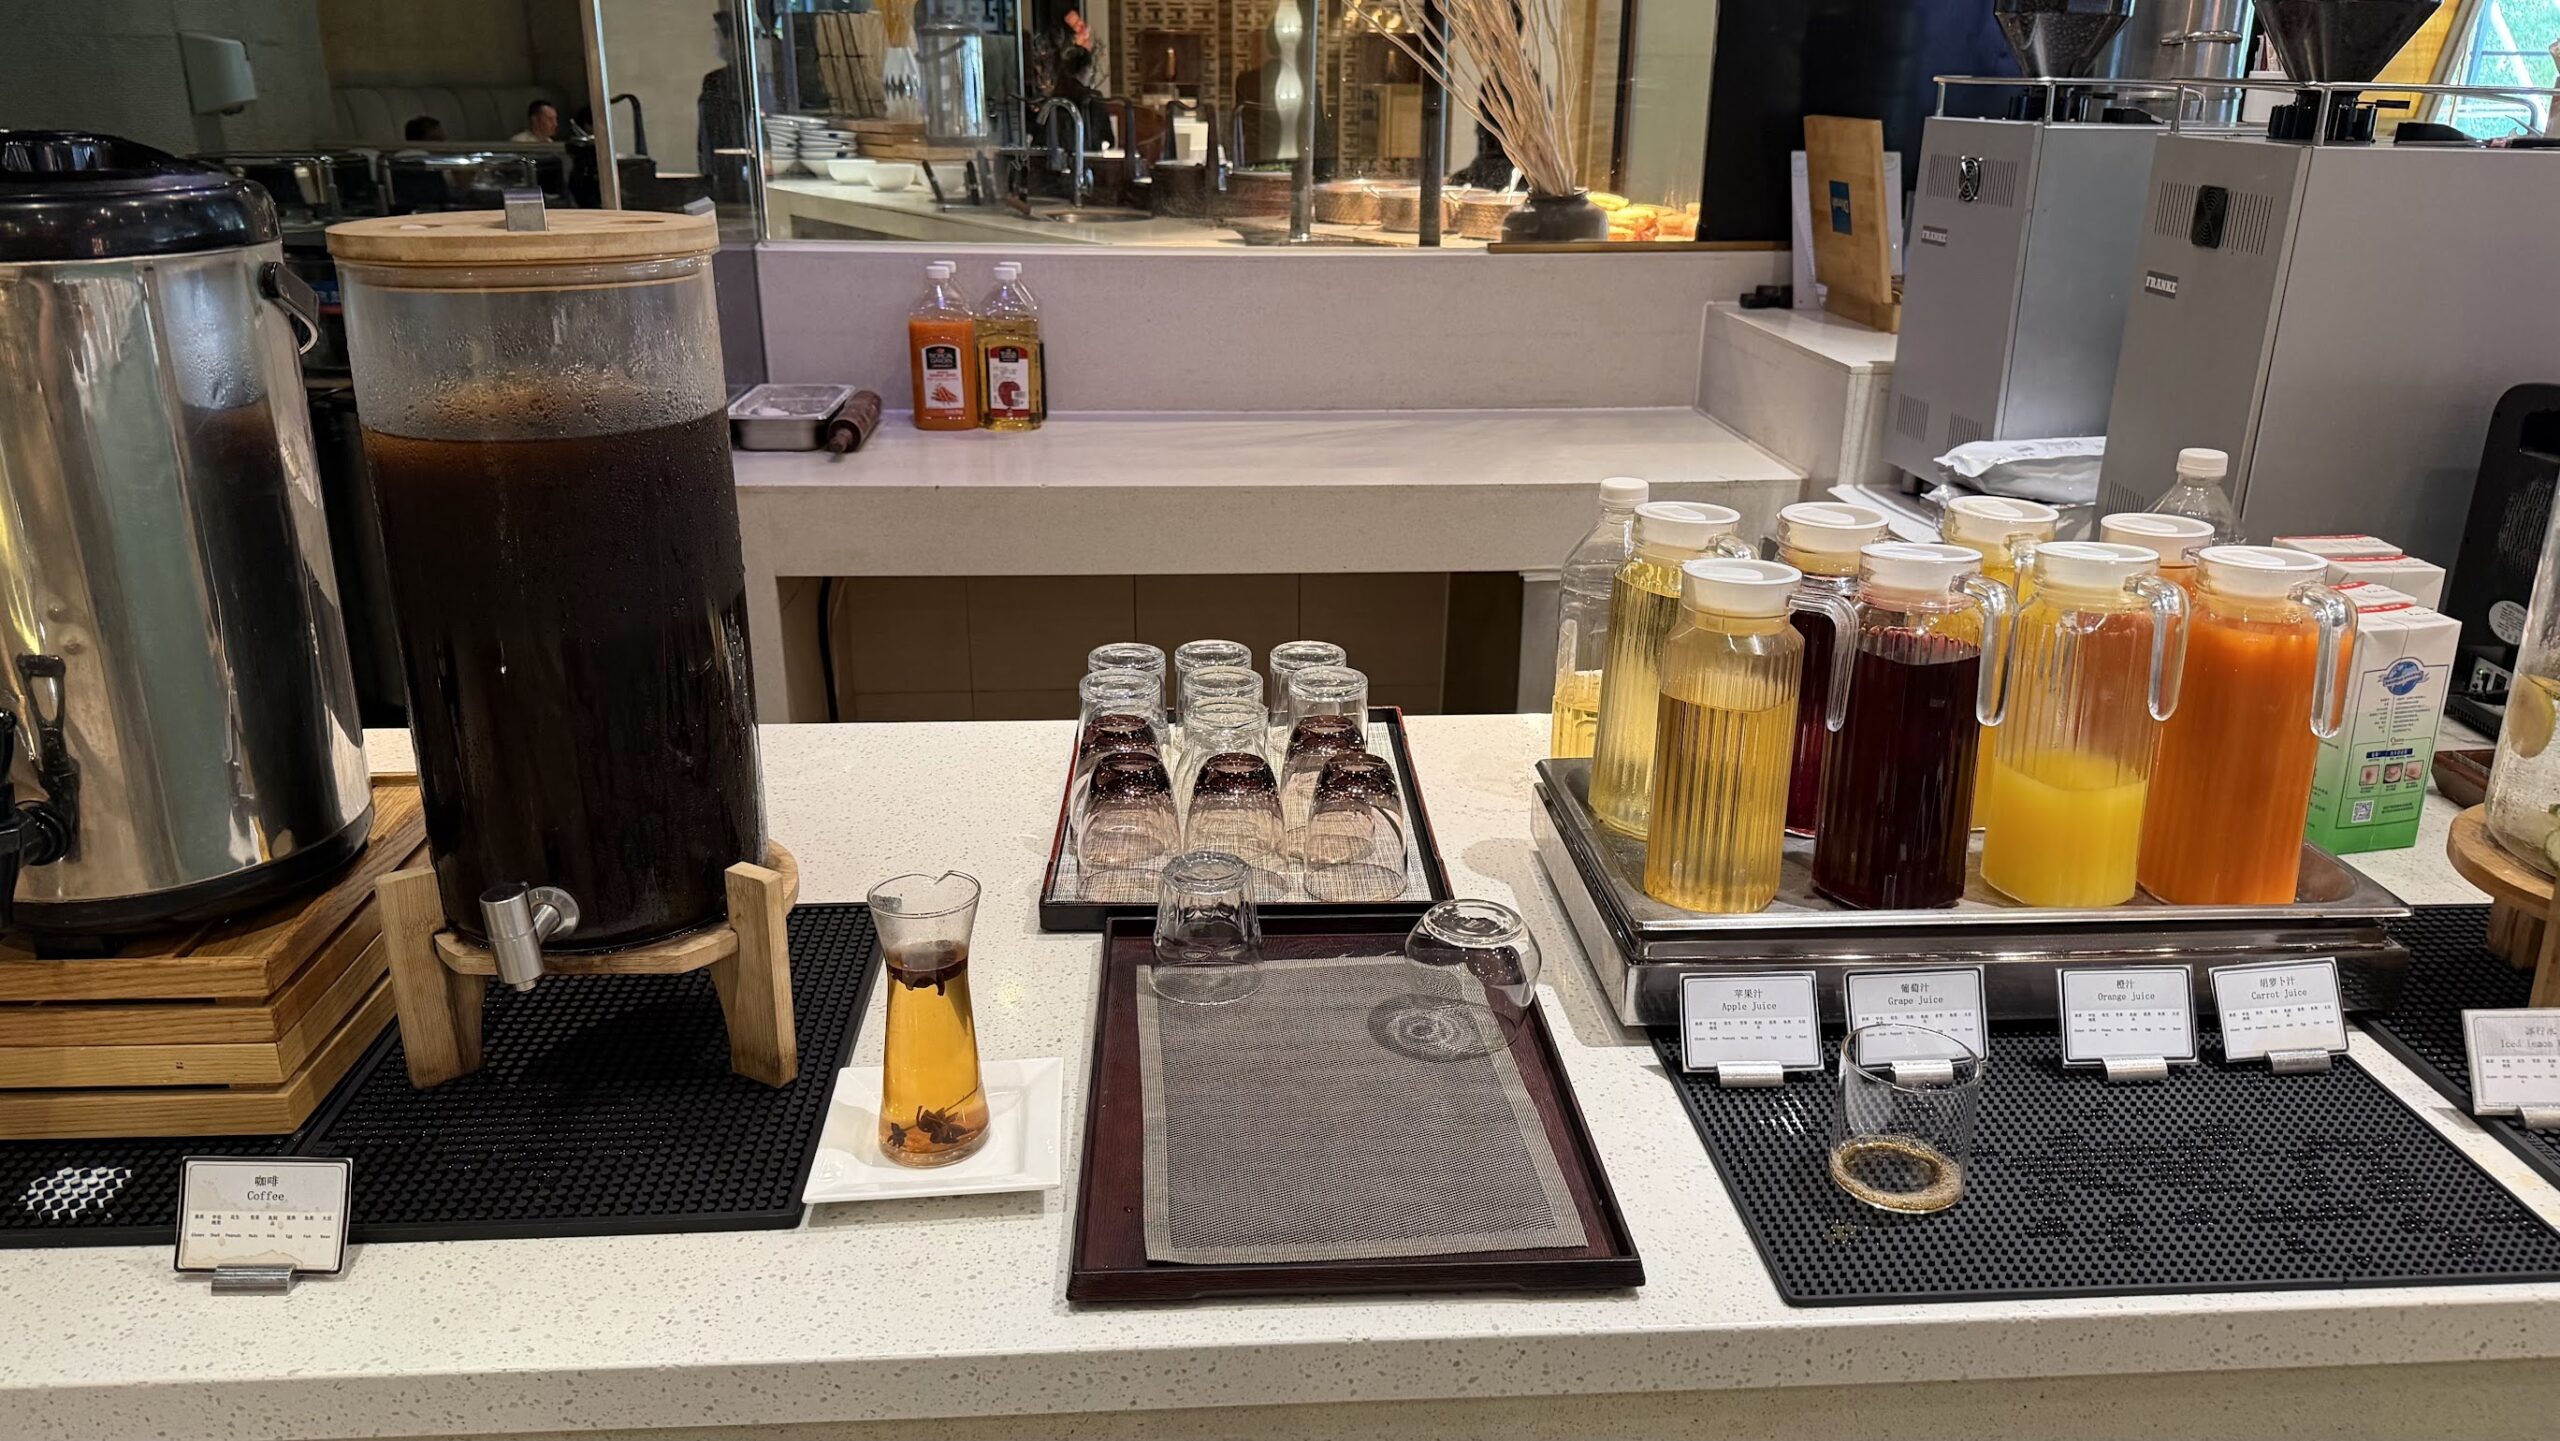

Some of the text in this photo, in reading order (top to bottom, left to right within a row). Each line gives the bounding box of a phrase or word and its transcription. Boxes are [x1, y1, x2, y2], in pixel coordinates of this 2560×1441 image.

[2145, 275, 2177, 294] FRANKE
[1733, 988, 1763, 1000] 苹果汁
[1900, 982, 1930, 994] 葡萄汁
[2251, 988, 2308, 1000] Carrot Juice
[1887, 995, 1944, 1006] Grape Juice
[2097, 992, 2127, 1002] Orange
[1721, 1001, 1777, 1012] Apple Juice
[254, 1175, 279, 1187] 咖啡
[247, 1190, 285, 1201] Coffee
